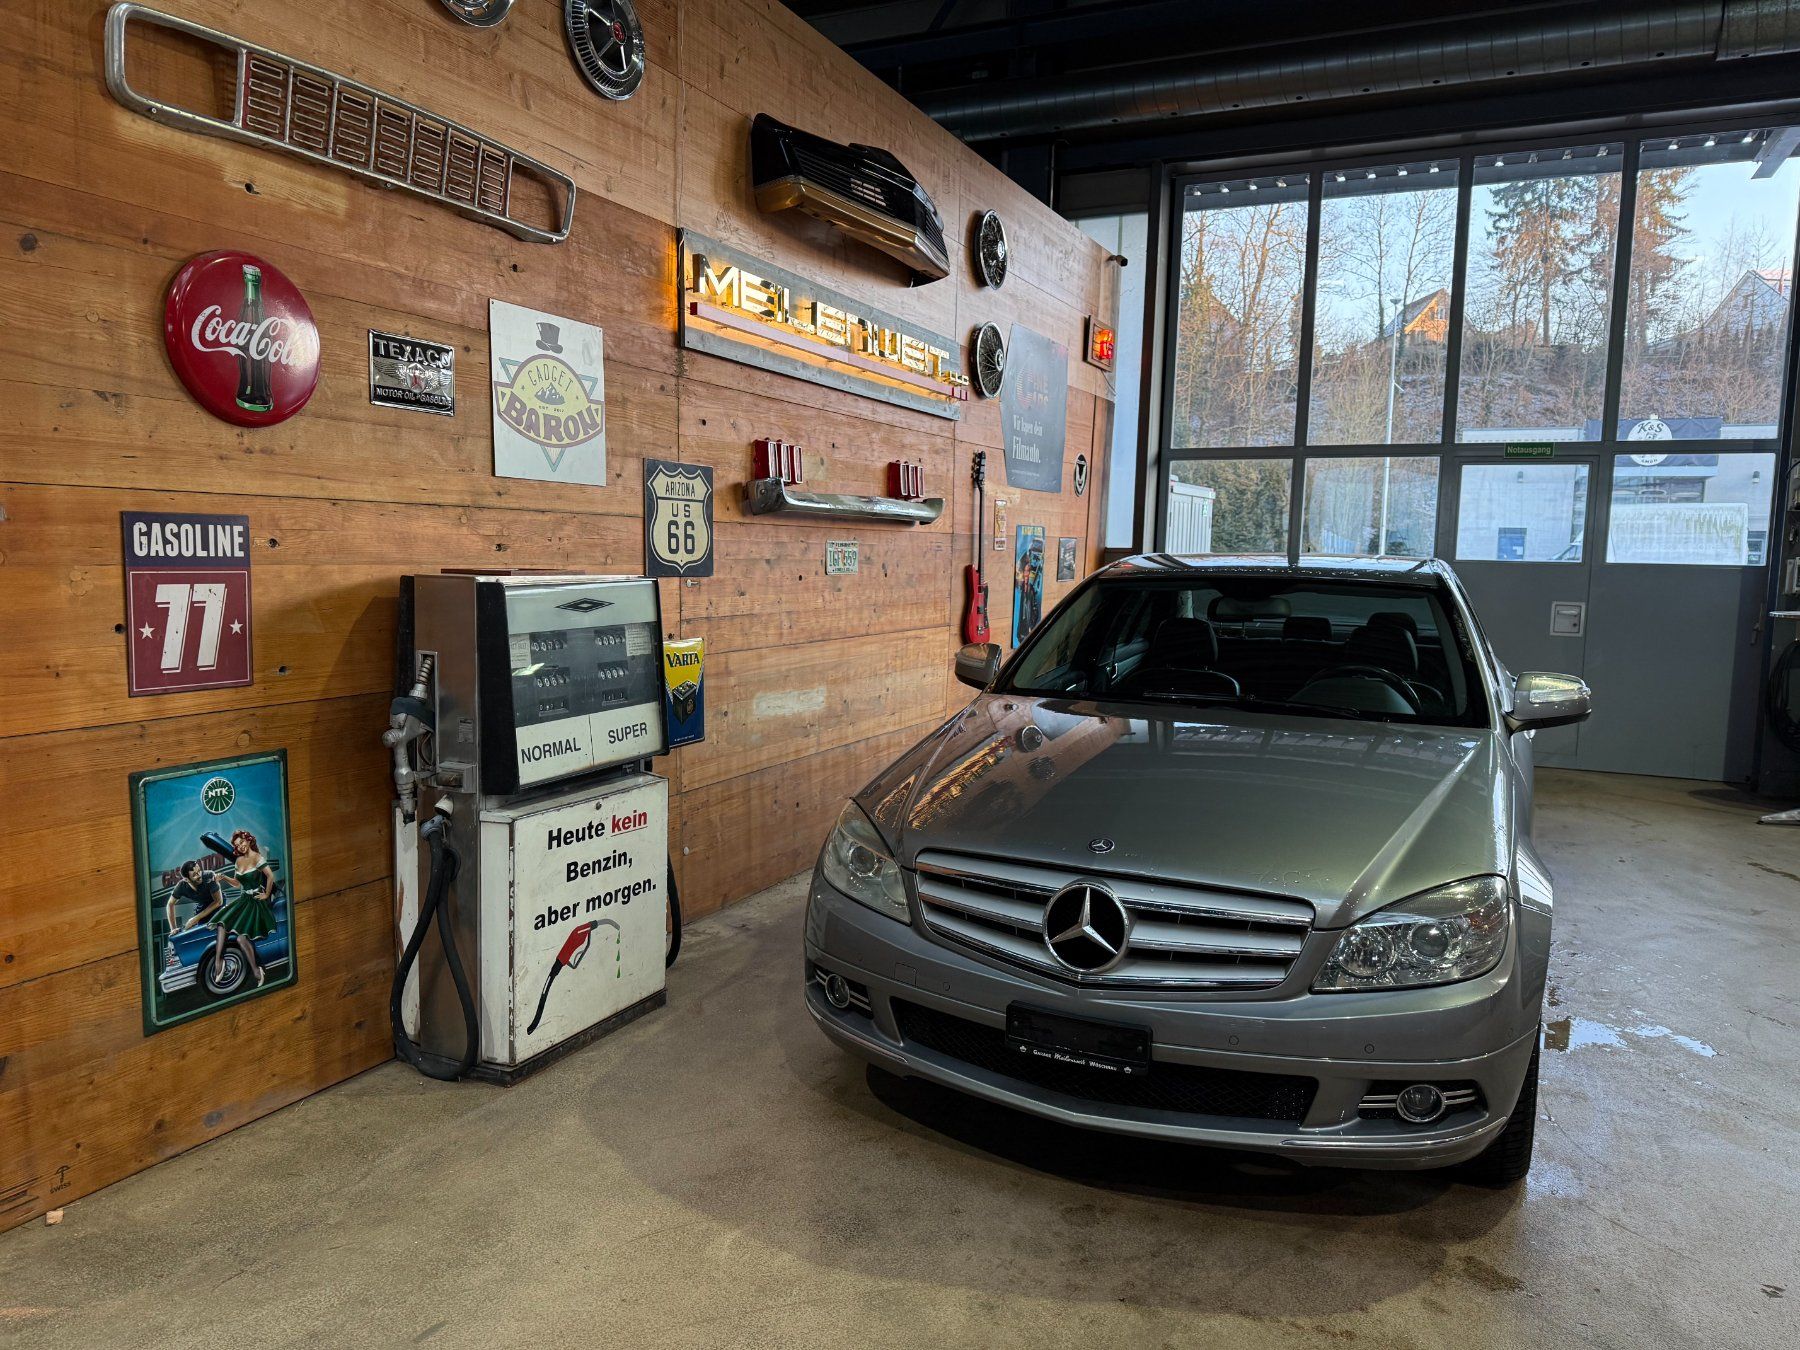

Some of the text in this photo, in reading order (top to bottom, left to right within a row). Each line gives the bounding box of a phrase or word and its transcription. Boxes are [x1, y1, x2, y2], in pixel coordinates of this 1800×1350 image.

[374, 338, 452, 368] TEXACO
[527, 363, 574, 392] GADGET
[376, 387, 452, 406] MOTOR OIL GASOLINE
[502, 390, 600, 443] BARON
[1637, 421, 1664, 434] K&S
[1507, 445, 1551, 455] Notausgang
[665, 481, 696, 498] ARIZONA
[133, 521, 245, 558] GASOLINE
[667, 520, 695, 555] 66
[665, 651, 700, 669] VARTA
[607, 722, 648, 744] SUPER
[521, 737, 582, 764] NORMAL
[208, 786, 229, 797] NTK
[547, 810, 648, 850] Heute kein
[566, 849, 633, 883] Benzin,
[533, 877, 657, 931] aber morgen.
